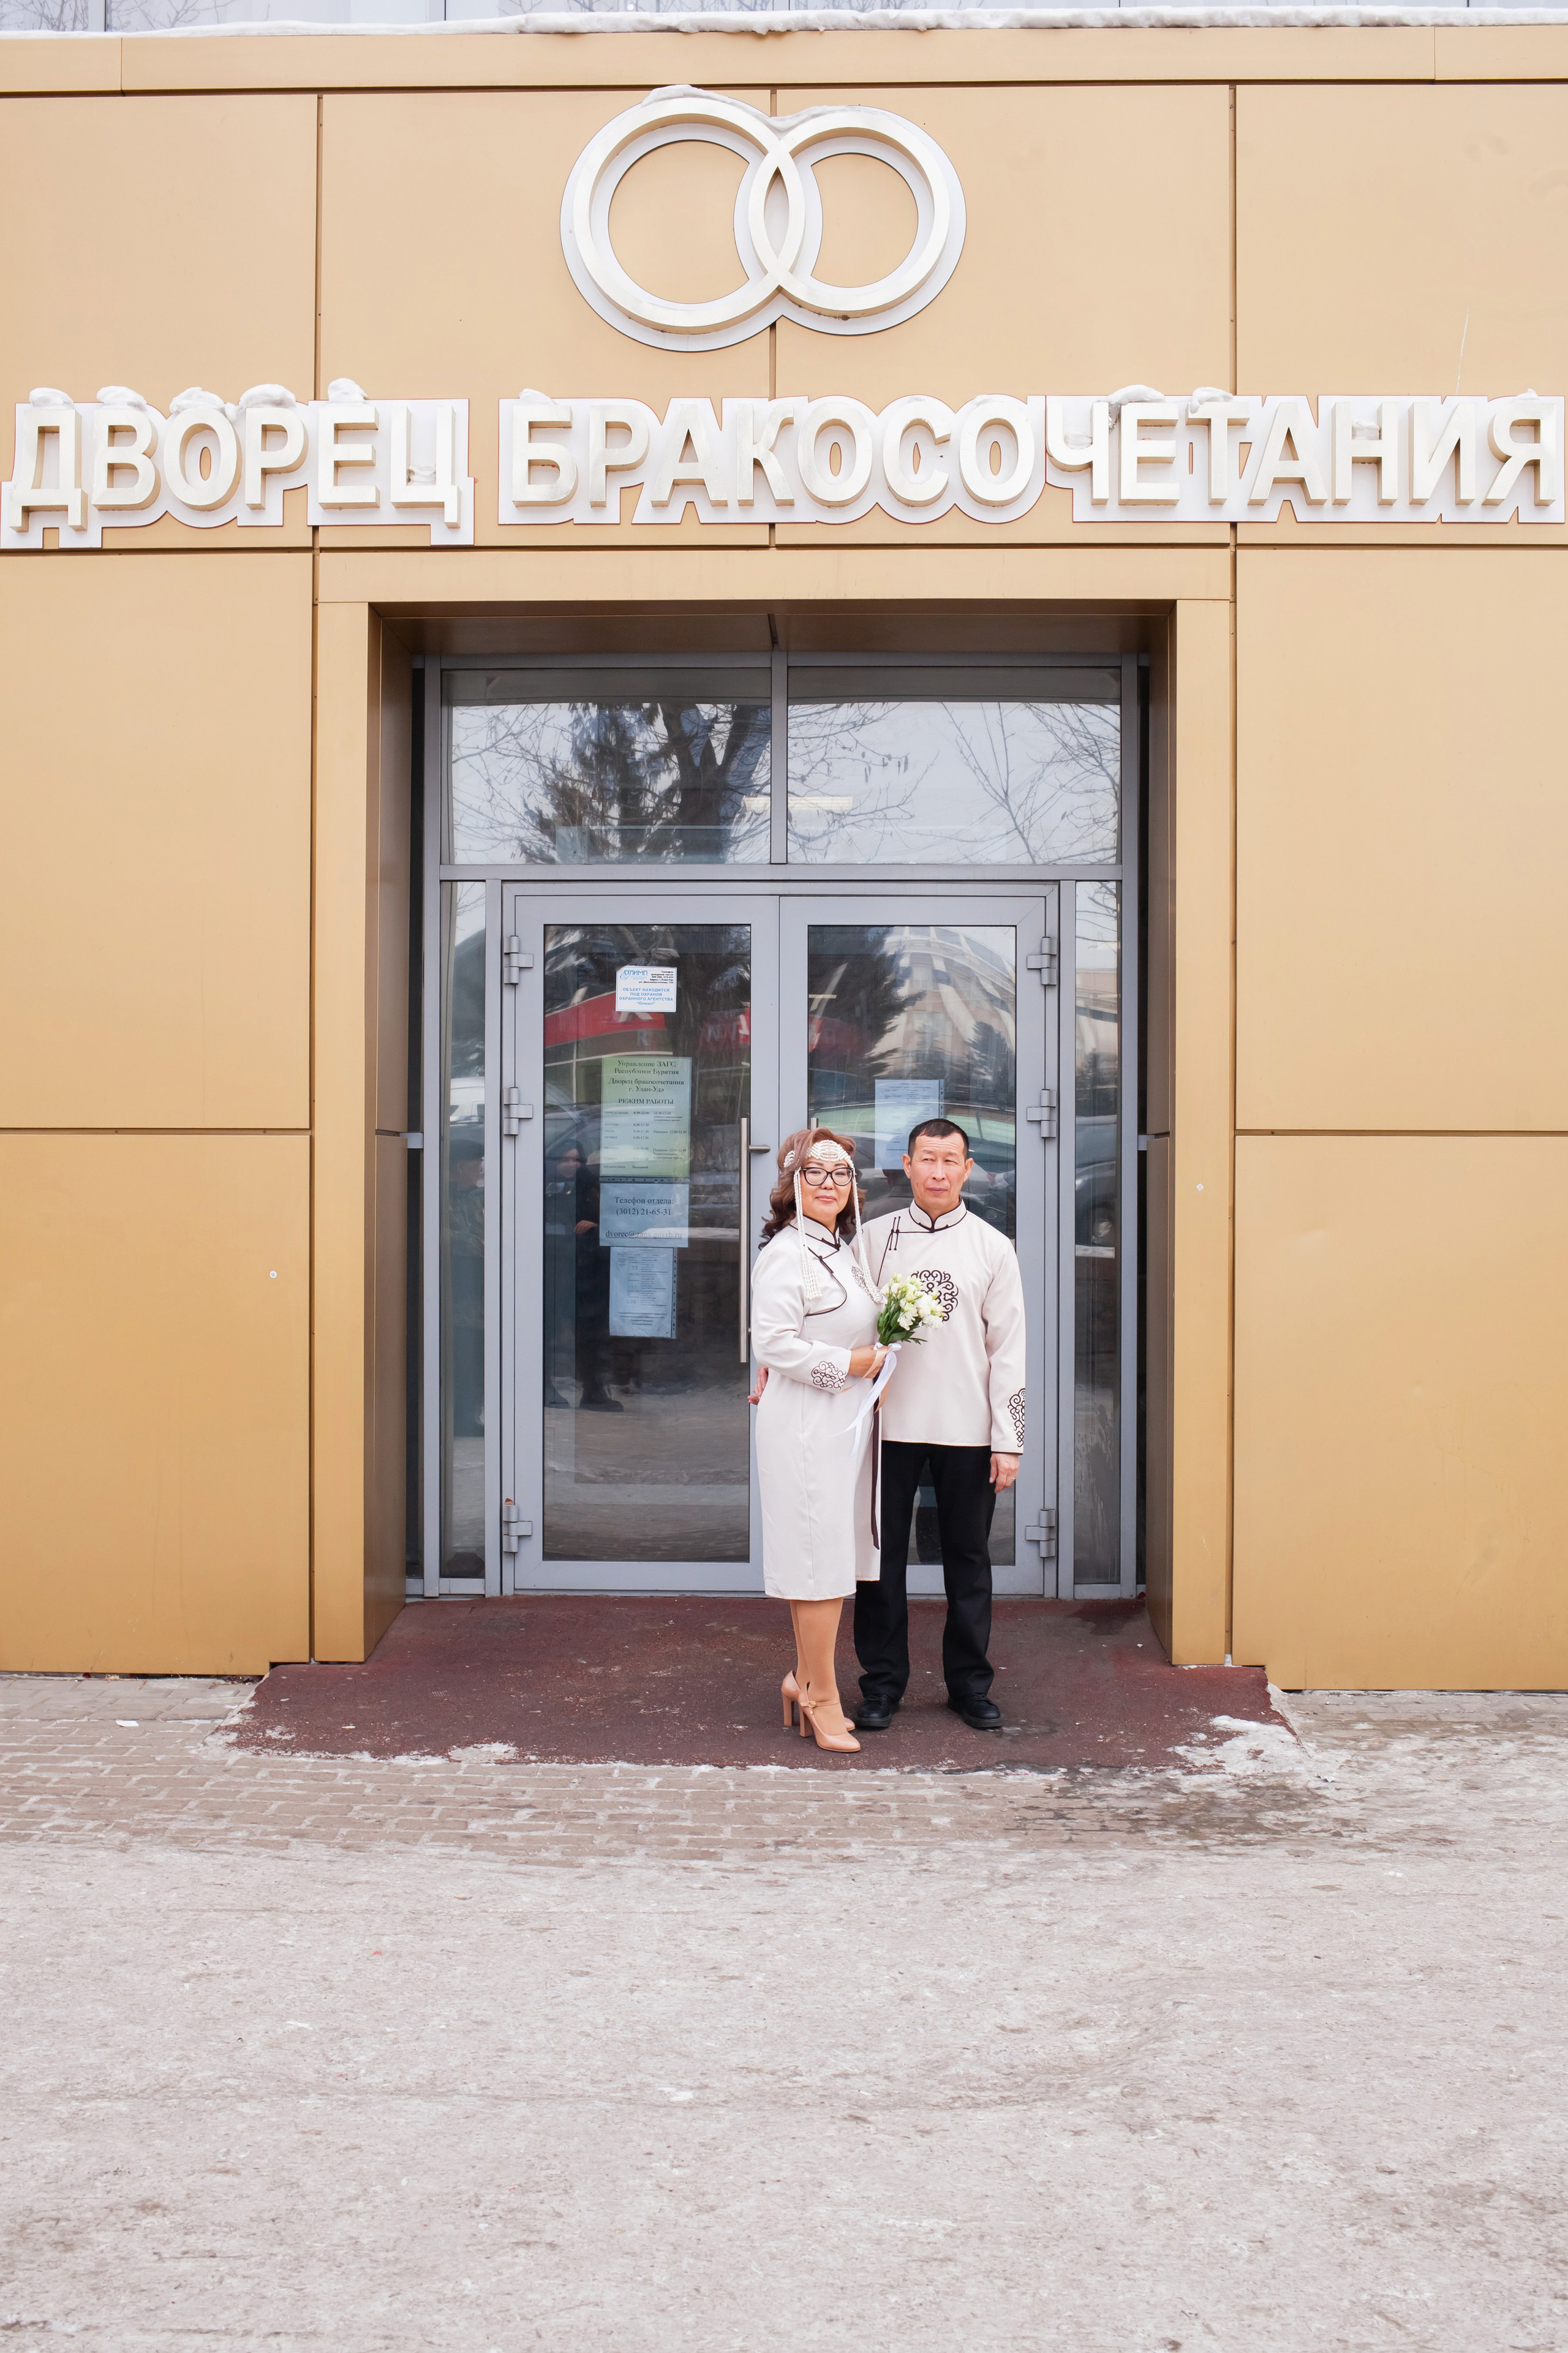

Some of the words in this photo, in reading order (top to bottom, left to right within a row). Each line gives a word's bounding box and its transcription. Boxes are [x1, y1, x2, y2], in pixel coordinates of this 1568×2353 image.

[8, 405, 461, 532] ДВОРЕЦ
[511, 400, 1557, 507] БРАКОСОЧЕТАНИЯ
[614, 1196, 646, 1206] Телефон
